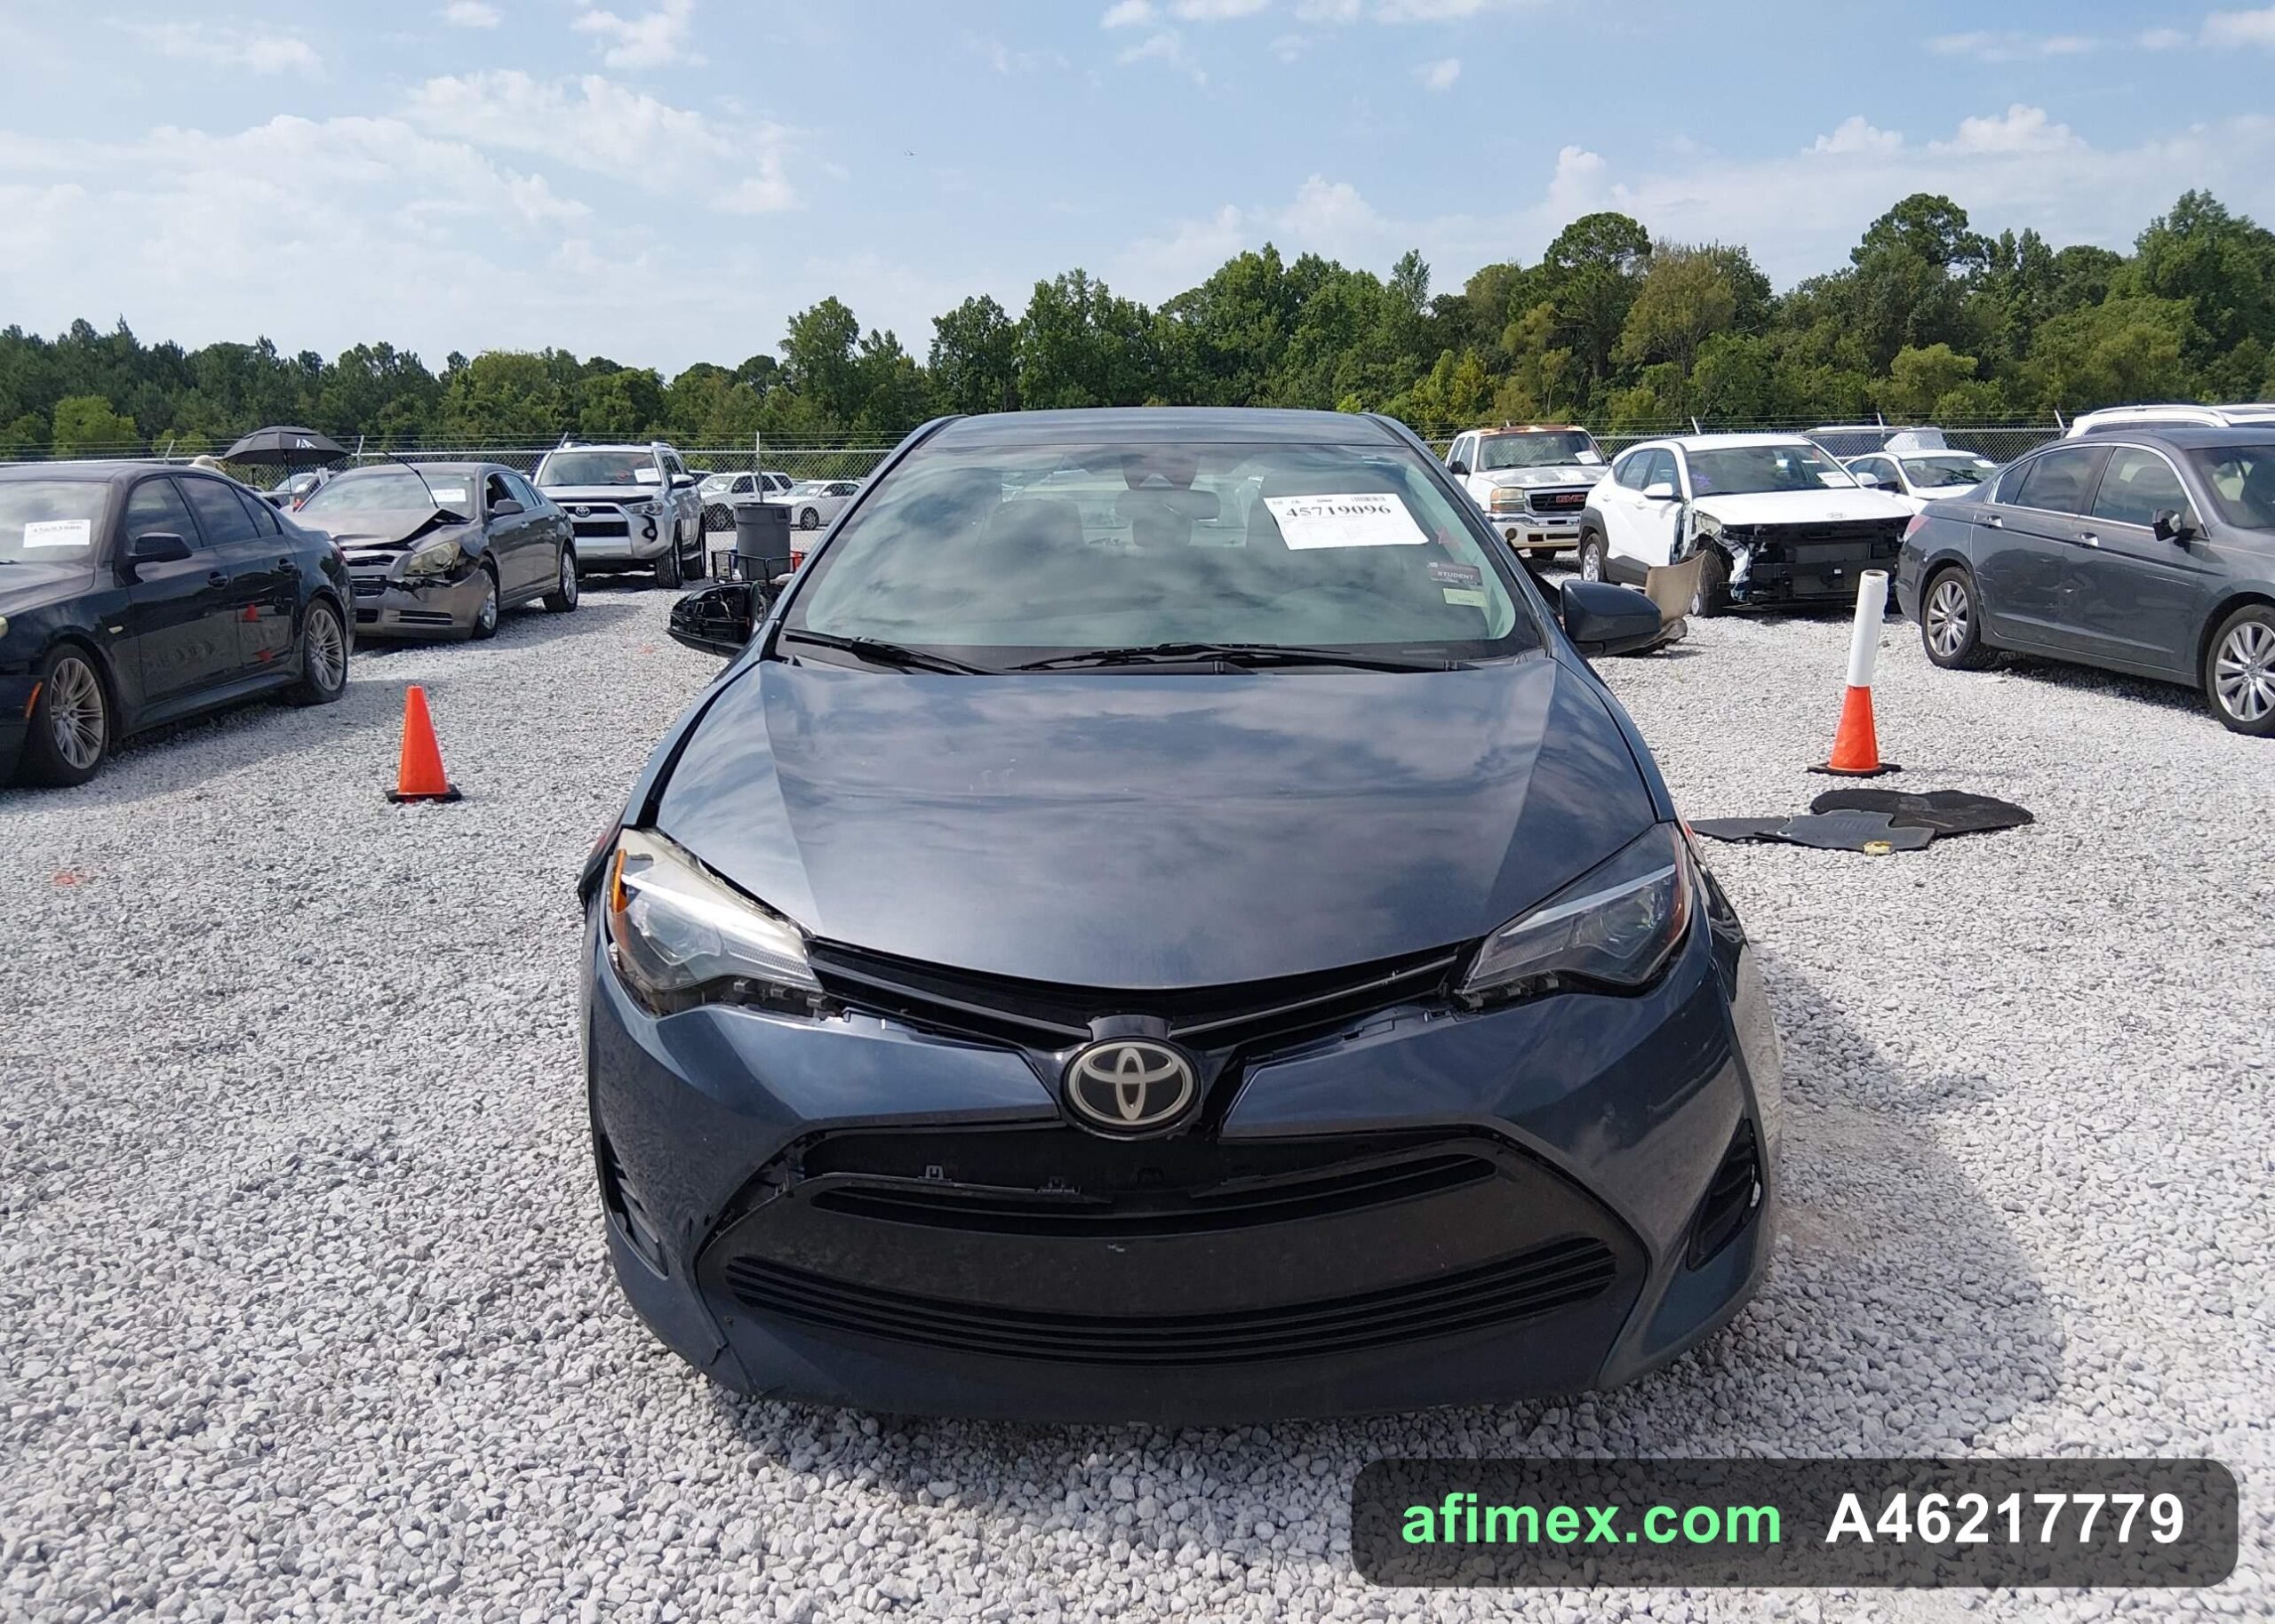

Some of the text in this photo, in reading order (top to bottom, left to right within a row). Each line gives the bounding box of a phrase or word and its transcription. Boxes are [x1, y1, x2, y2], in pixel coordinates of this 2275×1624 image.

[1555, 494, 1585, 504] GMC
[1286, 505, 1392, 518] 45719096
[1437, 571, 1474, 580] STUDENT
